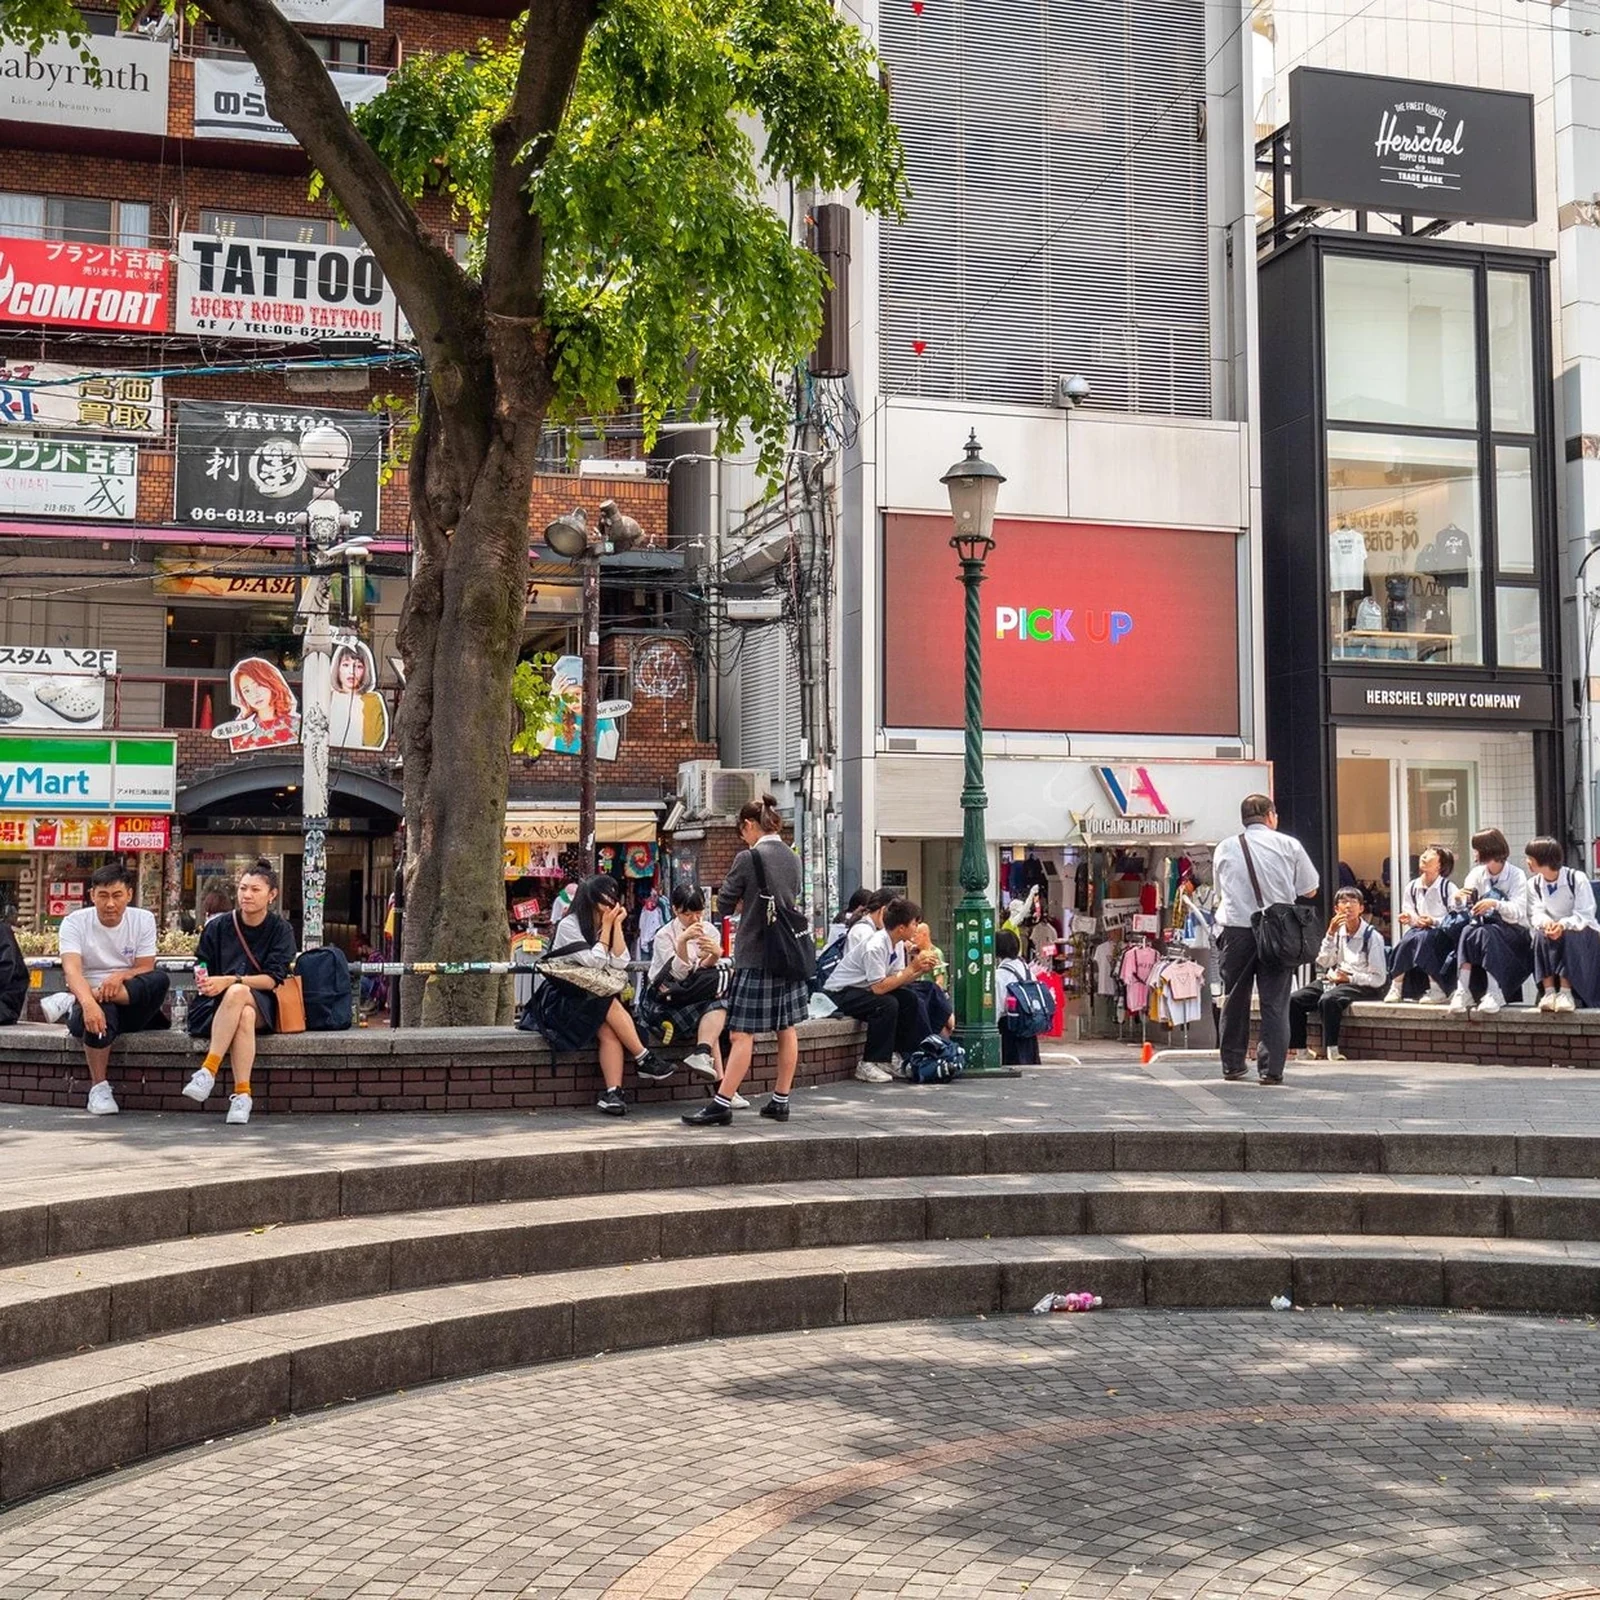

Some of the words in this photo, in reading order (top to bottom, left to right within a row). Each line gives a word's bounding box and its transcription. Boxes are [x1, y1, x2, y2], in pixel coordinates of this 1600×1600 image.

[0, 51, 150, 91] abyrinth
[11, 96, 33, 105] Like
[36, 100, 55, 109] and
[58, 101, 91, 113] beauty
[93, 105, 112, 114] you
[1394, 102, 1406, 113] THE
[1405, 101, 1424, 111] FINEST
[1425, 103, 1448, 120] QUALITY
[1374, 110, 1465, 157] Herschel
[1415, 125, 1426, 134] THE
[1398, 152, 1417, 163] SUPPLY
[1427, 155, 1445, 166] BRAND
[1397, 172, 1421, 182] TRADE
[1421, 174, 1444, 185] MARK
[192, 241, 384, 306] TATTOO
[8, 282, 163, 326] COMFORT
[190, 296, 245, 319] LUCKY
[251, 302, 305, 325] ROUND
[77, 402, 152, 430] 買取
[224, 411, 336, 432] TATTOO
[995, 606, 1075, 642] PICK
[1085, 611, 1133, 644] UP
[82, 650, 114, 670] 2F
[609, 703, 631, 713] salon
[1366, 689, 1423, 705] HERSCHEL
[1426, 691, 1466, 707] SUPPLY
[1469, 692, 1521, 709] COMPANY
